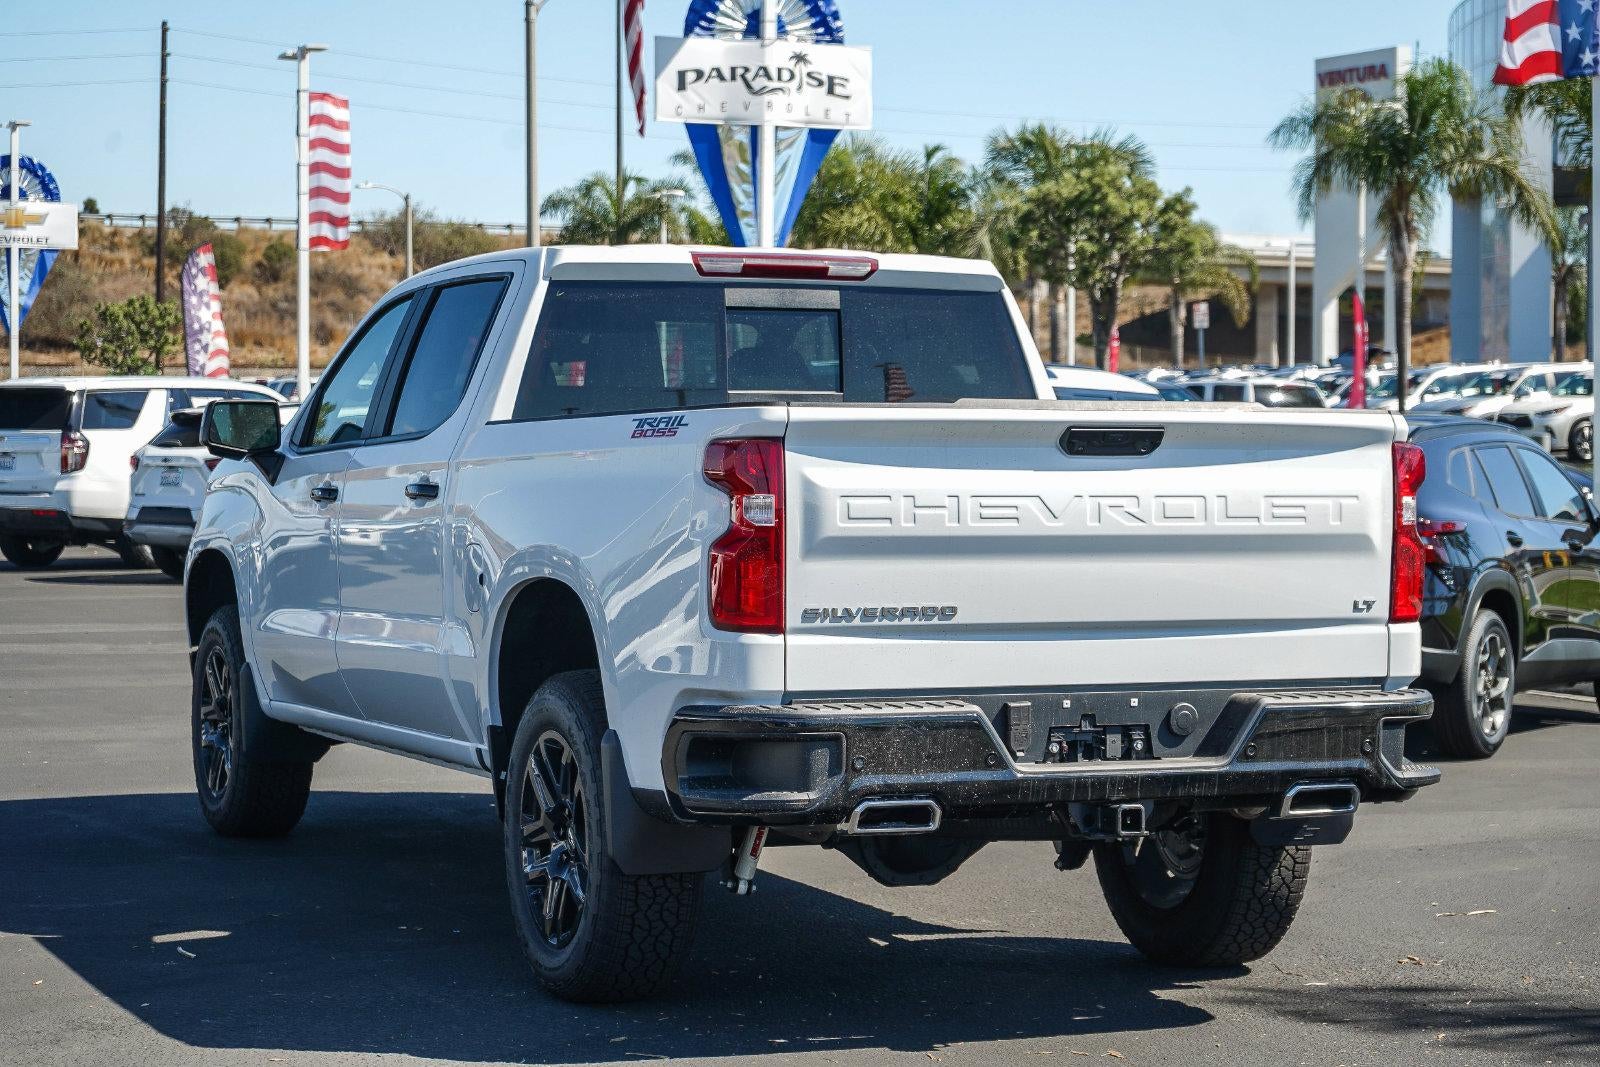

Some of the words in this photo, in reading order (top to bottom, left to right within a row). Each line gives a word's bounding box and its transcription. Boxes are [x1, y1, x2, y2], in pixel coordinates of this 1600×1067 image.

[677, 52, 852, 99] PARADISE
[1318, 63, 1388, 88] VENTURA
[674, 101, 851, 124] CHEVROLET
[632, 415, 688, 429] TRAIL
[630, 427, 679, 439] BOSS
[836, 495, 1359, 527] CHEVROLET
[801, 606, 958, 623] SILVERADO
[1352, 600, 1376, 613] LT
